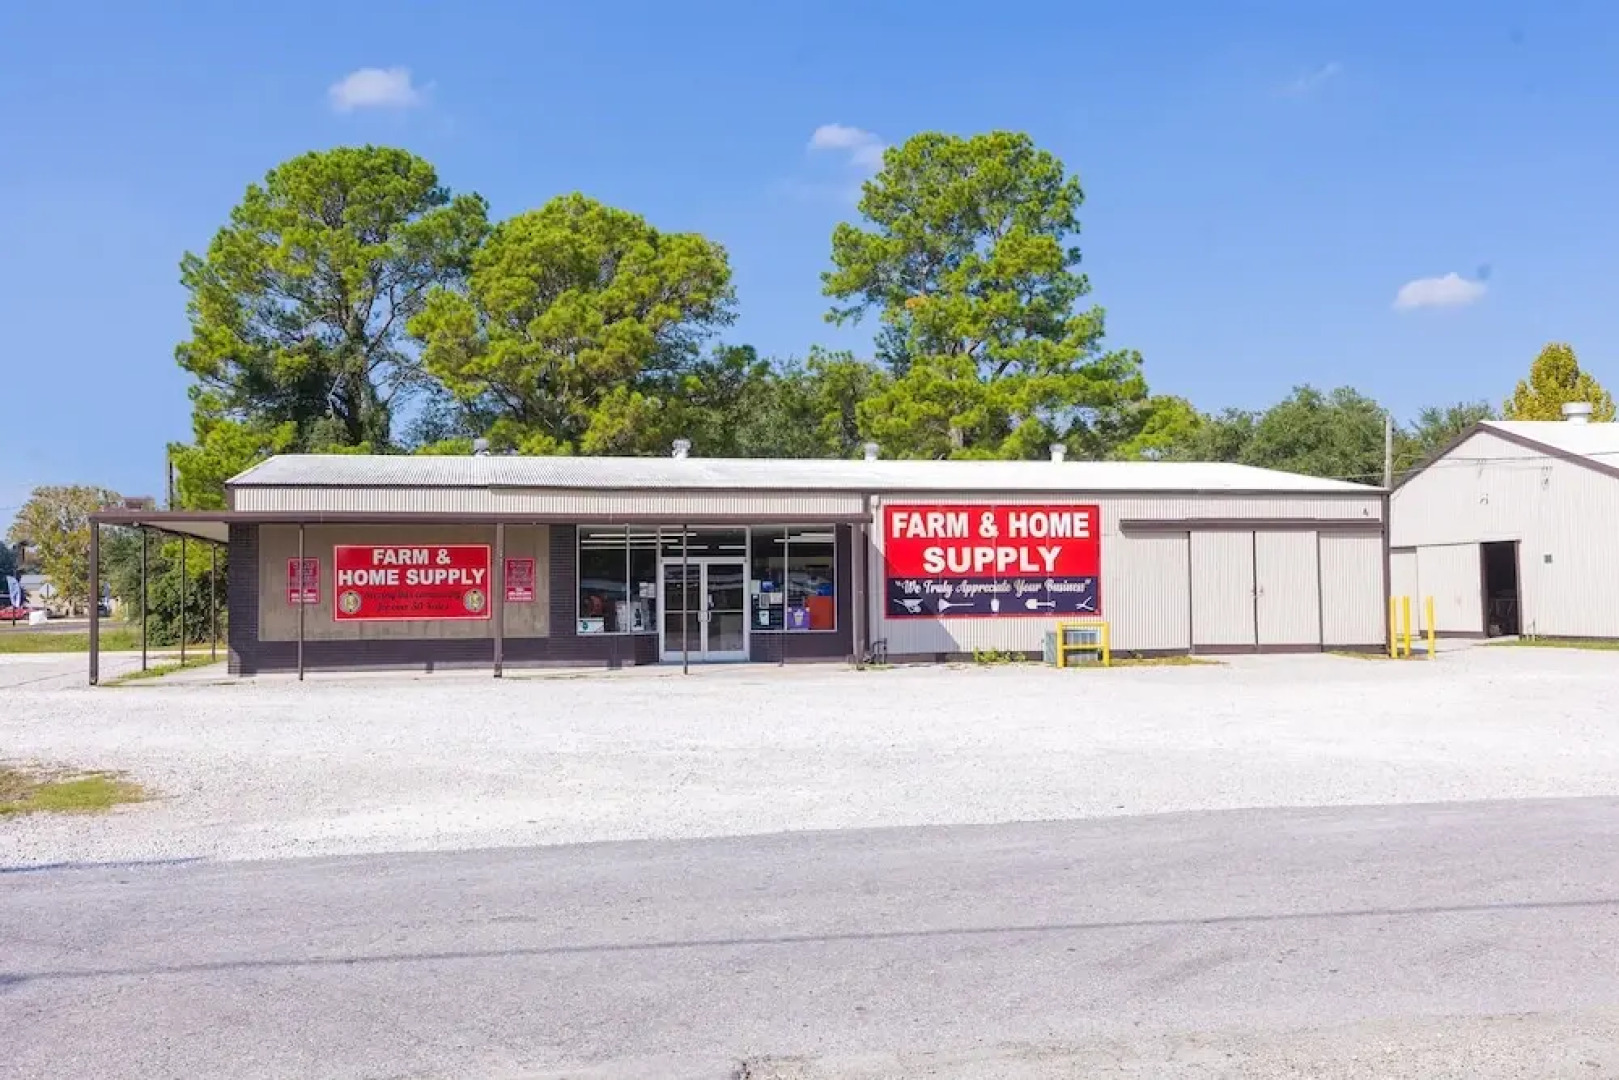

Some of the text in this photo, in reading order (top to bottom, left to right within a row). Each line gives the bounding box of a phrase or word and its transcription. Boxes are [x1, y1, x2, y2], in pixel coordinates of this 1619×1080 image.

[892, 511, 1089, 538] FARM & HOME
[373, 548, 451, 565] FARM &
[922, 546, 1062, 573] SUPPLY
[338, 569, 399, 586] HOME
[406, 569, 486, 586] SUPPLY
[922, 580, 953, 598] Truly
[956, 580, 1010, 597] Appreciate
[1013, 580, 1041, 598] Your
